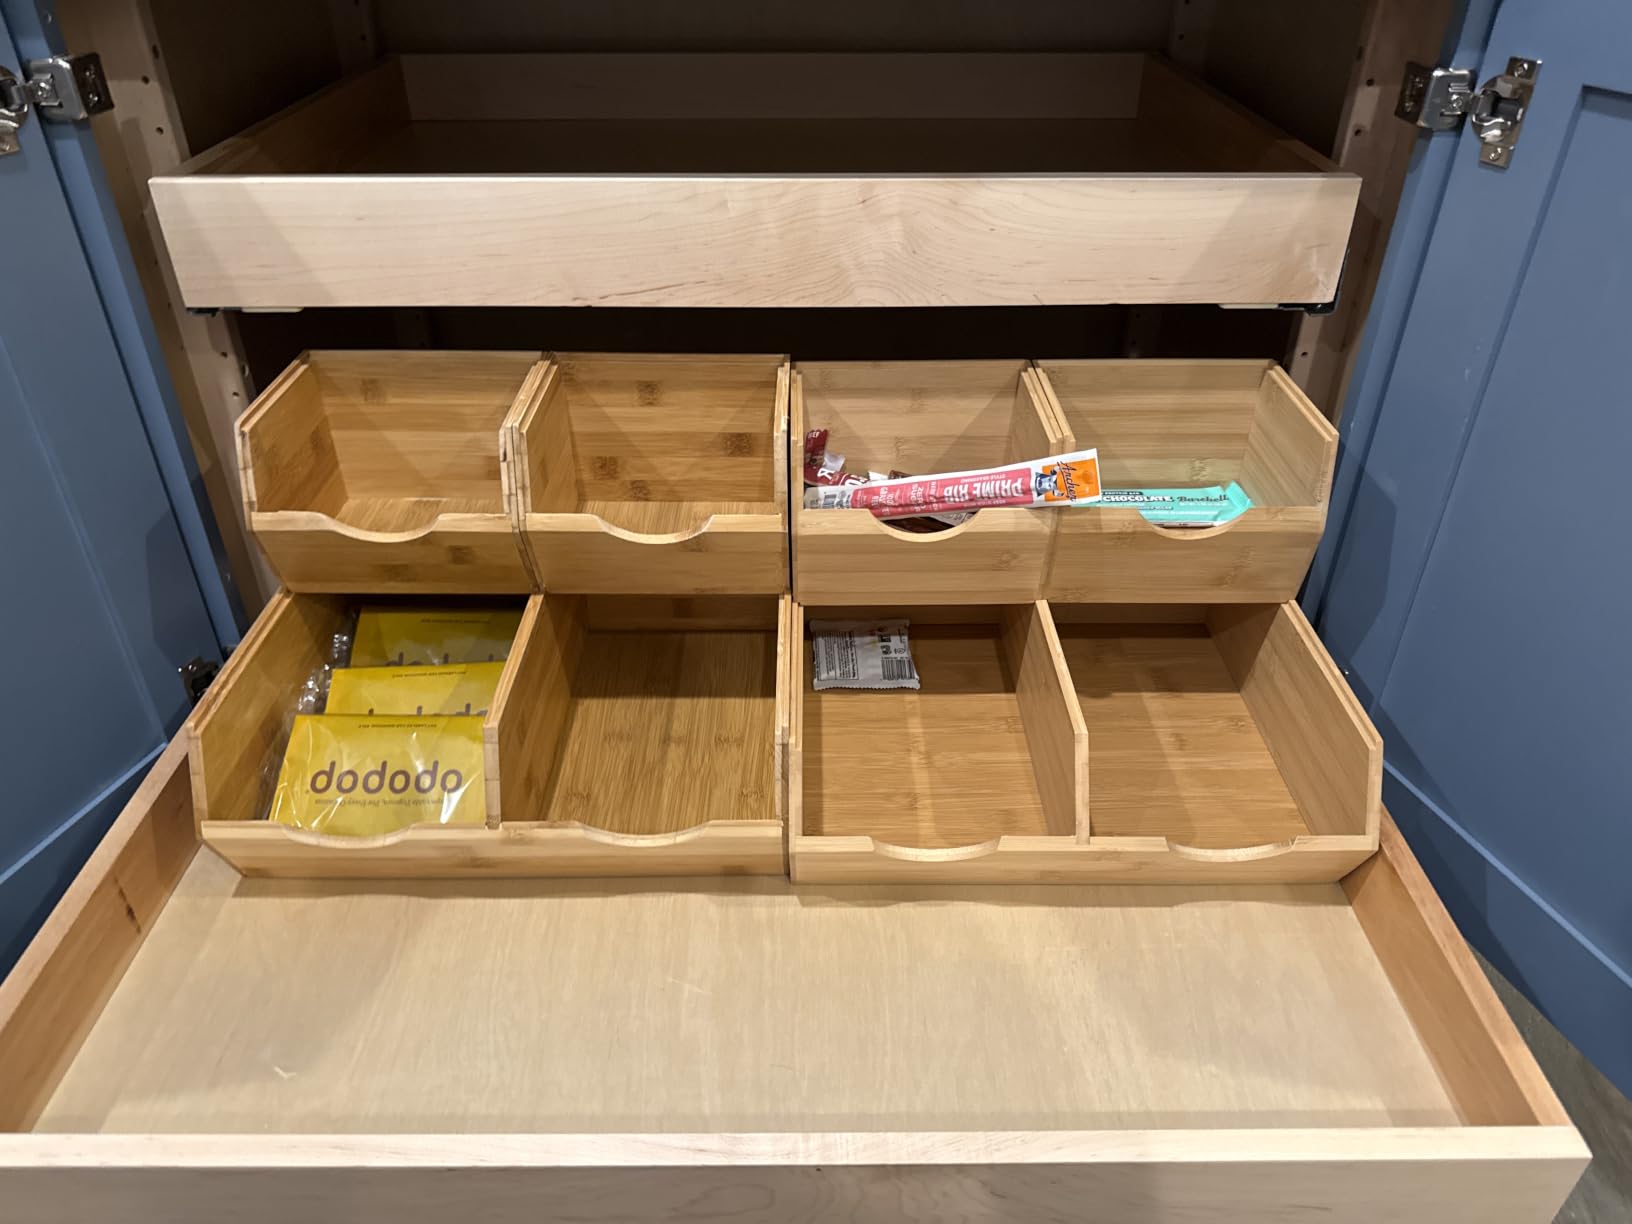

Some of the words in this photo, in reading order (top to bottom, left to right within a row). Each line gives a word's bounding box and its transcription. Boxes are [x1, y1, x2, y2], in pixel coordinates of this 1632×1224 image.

[972, 477, 1024, 498] PRIME
[1057, 461, 1080, 503] Archer
[943, 484, 969, 504] RIB
[1102, 494, 1174, 503] CHOCOLATE
